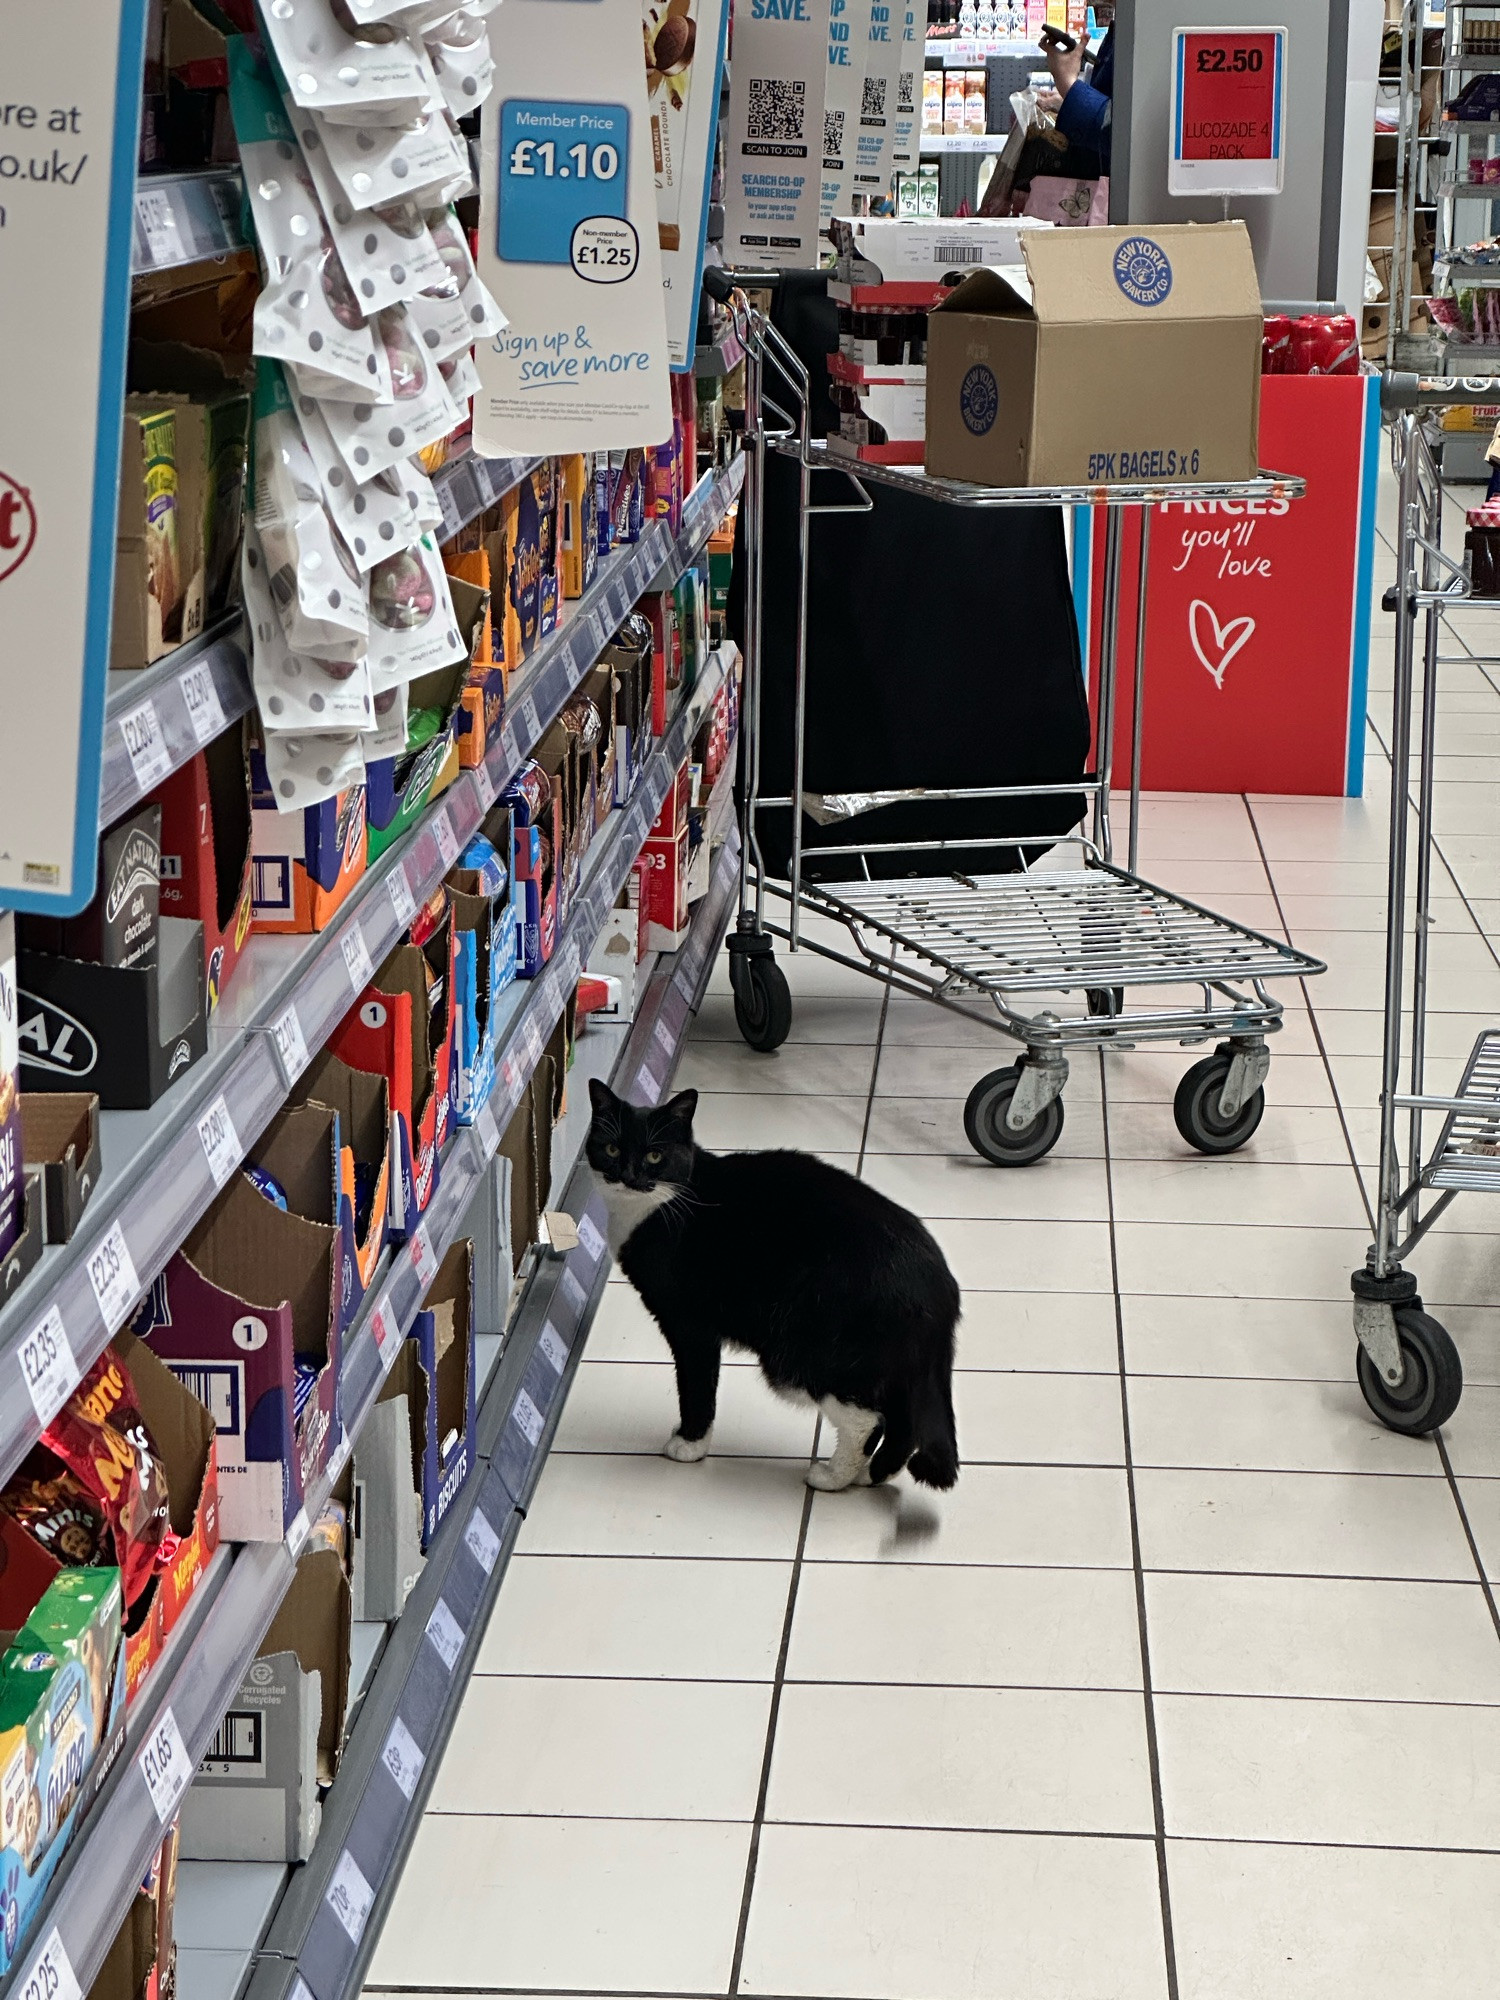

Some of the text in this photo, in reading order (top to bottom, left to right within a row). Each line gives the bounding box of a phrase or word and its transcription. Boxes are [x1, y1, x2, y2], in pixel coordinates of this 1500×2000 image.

[751, 0, 810, 21] SAVE.
[1197, 48, 1263, 73] £2.50
[0, 103, 82, 134] re at
[516, 112, 614, 130] Member Price
[1185, 121, 1269, 139] LUCOZADE 4
[653, 127, 662, 162] CARAMEL
[661, 100, 674, 187] CHOCOLATE ROUNDS
[746, 145, 803, 156] SCAN TO JOIN
[1209, 144, 1245, 159] PACK
[0, 148, 88, 185] o.uk/
[509, 139, 619, 181] £1.10
[742, 173, 805, 188] SEARCH CO-OP
[744, 187, 802, 199] MEMBERSHIP
[582, 229, 628, 239] Non-member
[596, 238, 613, 246] Price
[577, 246, 632, 266] £1.25
[1116, 241, 1168, 272] NEW YORK
[1122, 279, 1160, 302] BAKERY
[492, 325, 592, 359] Sign up &
[519, 352, 650, 381] save more
[1088, 453, 1117, 480] 5PK
[1119, 450, 1176, 478] BAGELS
[1191, 449, 1200, 475] 6
[1172, 519, 1256, 572] you'll
[1217, 549, 1272, 579] love
[111, 862, 127, 911] EAT
[132, 893, 144, 917] dark
[124, 912, 152, 944] chocolate
[369, 1006, 378, 1022] 1
[18, 1012, 75, 1064] AL
[201, 1109, 226, 1157] £2.80
[92, 1237, 120, 1297] £2.35
[243, 1323, 253, 1342] 1
[24, 1322, 57, 1386] £2.35
[238, 1466, 248, 1474] DE
[438, 1448, 467, 1521] BISCUITS
[239, 1685, 286, 1696] Corrugated
[243, 1696, 282, 1705] Recycles
[95, 1726, 125, 1792] CHOCOLATE
[145, 1728, 172, 1789] £1.65
[223, 1763, 230, 1773] 5
[25, 1952, 59, 2000] £2.25
